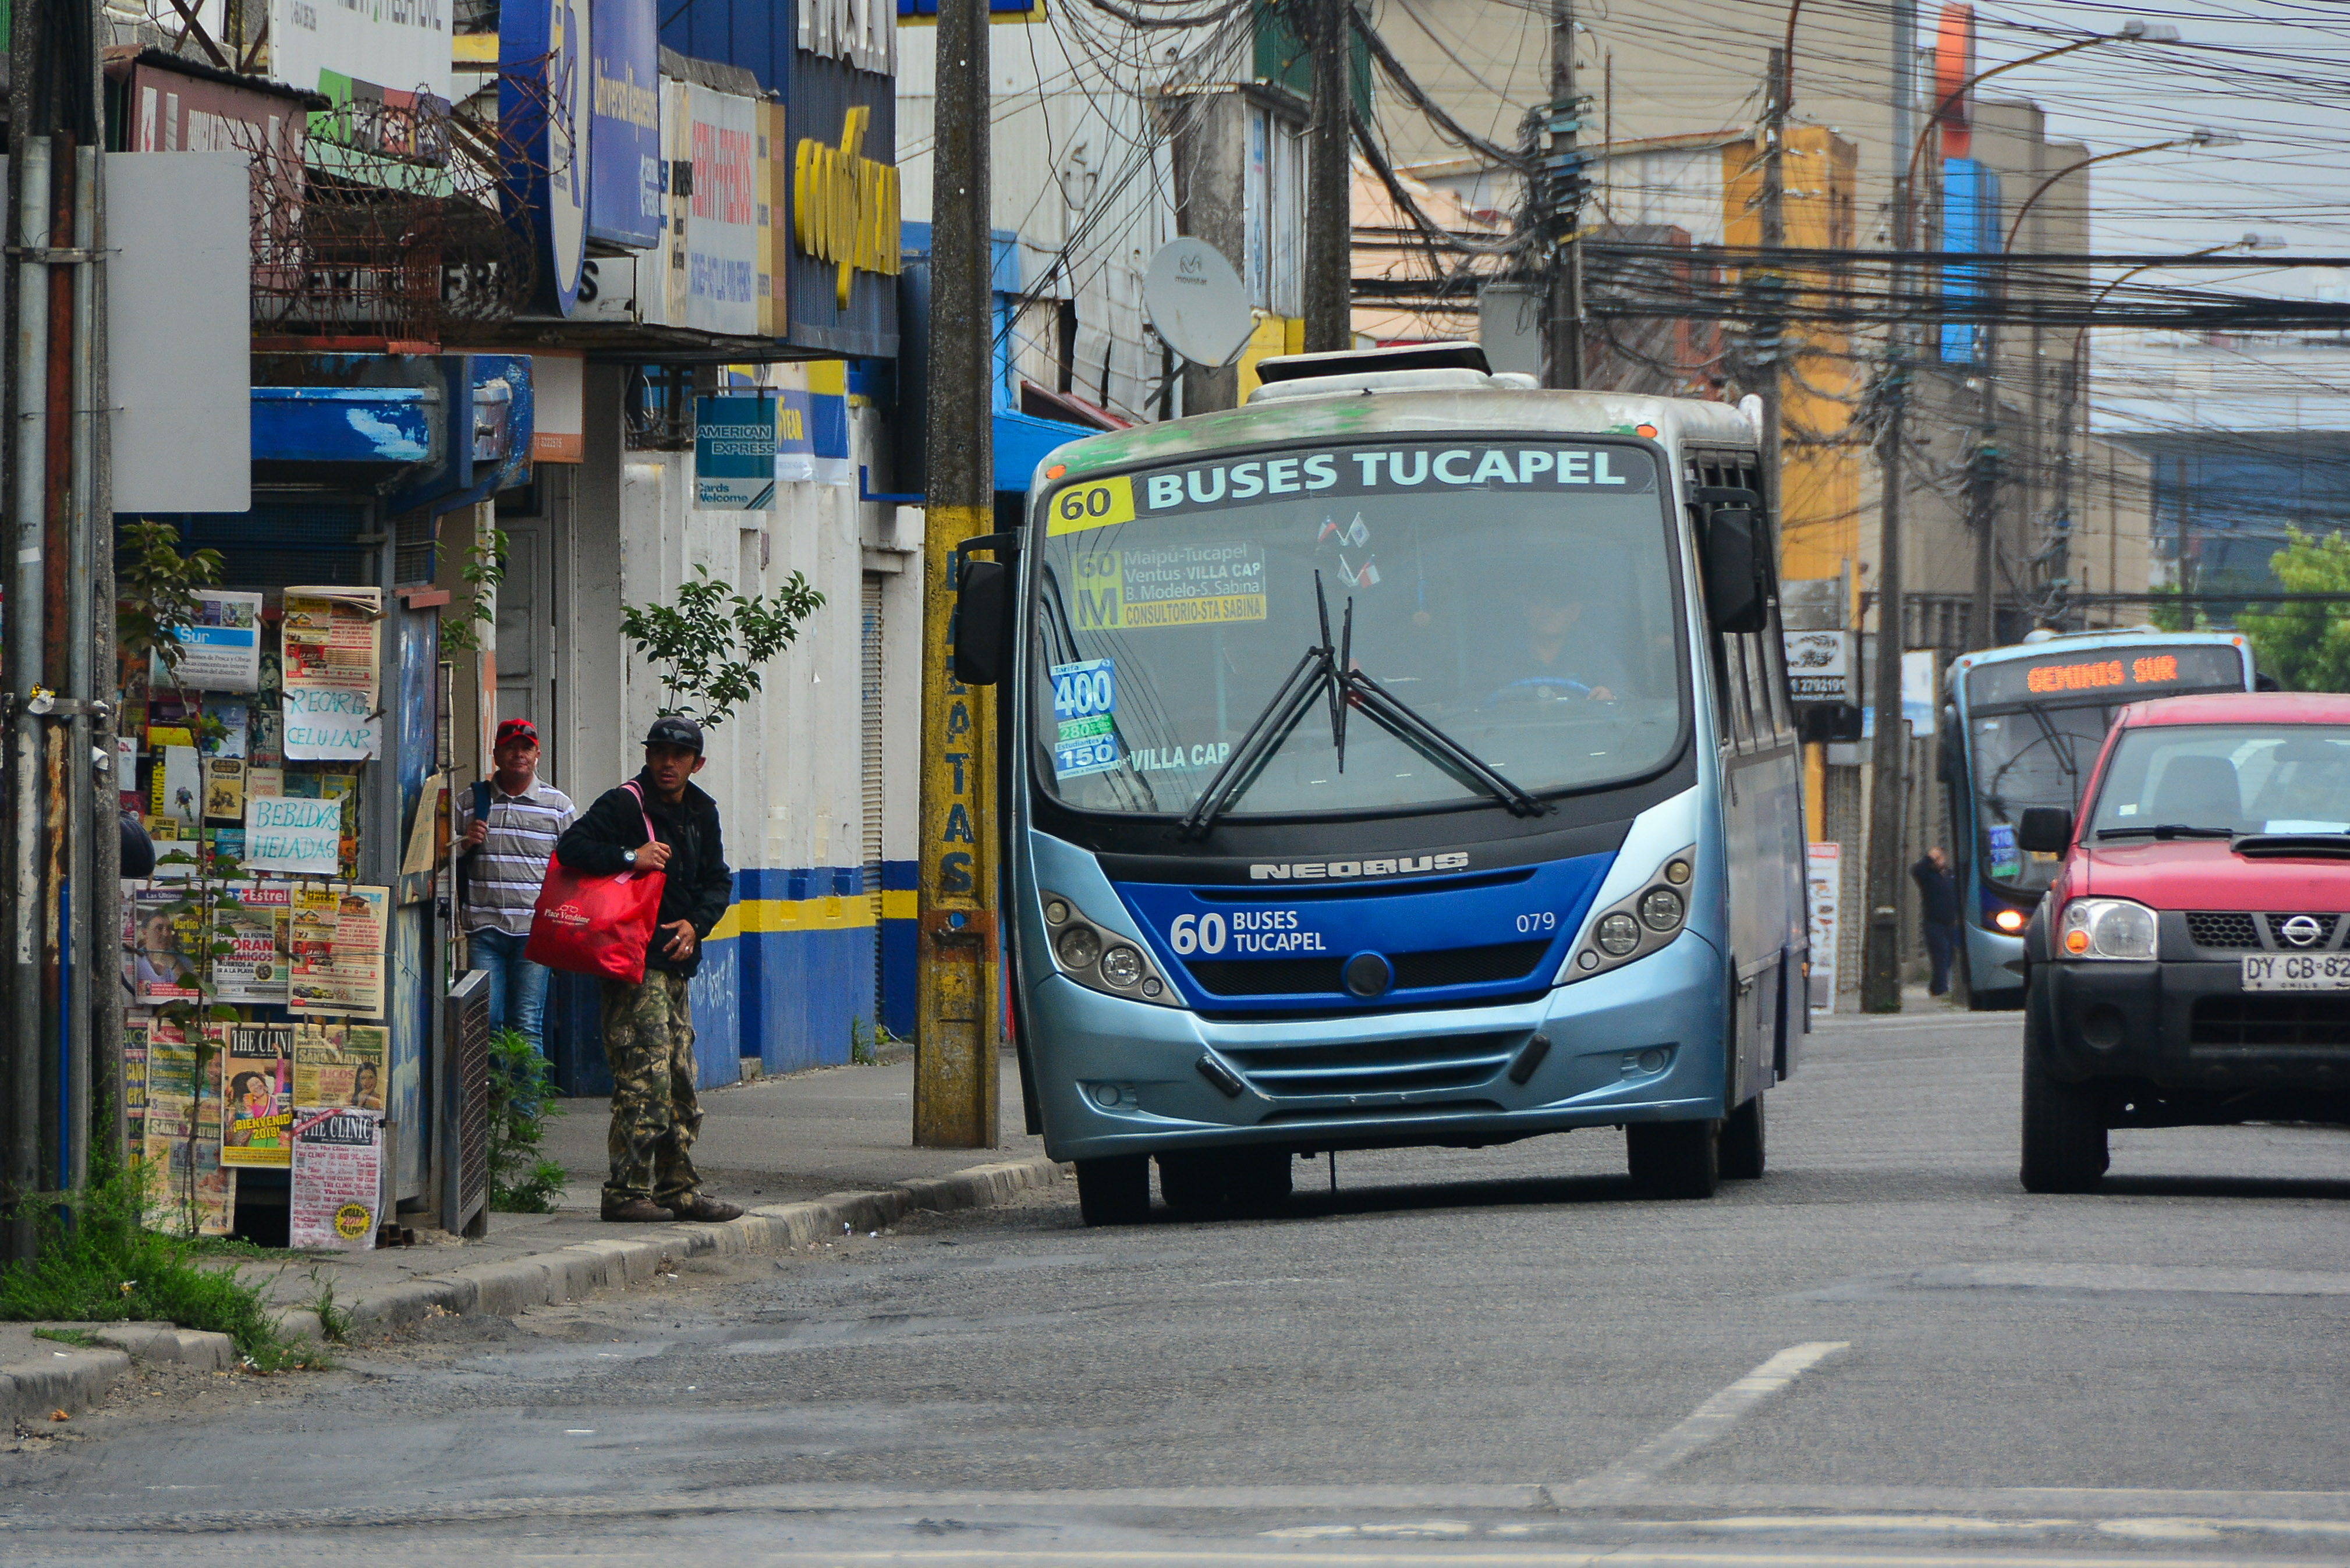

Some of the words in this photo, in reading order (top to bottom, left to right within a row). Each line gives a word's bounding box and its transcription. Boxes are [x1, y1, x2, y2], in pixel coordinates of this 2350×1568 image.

[692, 119, 752, 226] SERVI-FRENOS
[1174, 276, 1208, 288] movistar
[698, 425, 771, 439] AMERICAN
[712, 442, 775, 456] EXPRESS
[1059, 487, 1113, 522] 60
[1147, 454, 1337, 511] BUSES
[1352, 448, 1626, 487] TUCAPEL
[699, 492, 749, 503] Welcome
[1078, 553, 1116, 579] 60
[1124, 568, 1181, 583] Ventus
[1186, 565, 1228, 580] VILLA
[1232, 562, 1261, 577] CAP
[1215, 580, 1260, 595] Sabina
[1079, 587, 1119, 627] M
[1223, 597, 1262, 618] SABINA
[180, 627, 210, 643] Sur
[1055, 664, 1080, 674] Tarifa
[2133, 655, 2178, 683] SUR
[1055, 670, 1112, 716] 400
[287, 726, 371, 749] CELULAR
[1060, 724, 1090, 740] 280
[1057, 737, 1100, 750] Estudiantes
[1059, 744, 1114, 768] 150
[1131, 746, 1186, 771] VILLA
[1191, 742, 1231, 766] CAP
[256, 801, 341, 831] BEBIDAS
[253, 835, 338, 860] HELADAS
[1250, 852, 1469, 879] NEOBUS
[249, 889, 288, 902] Estrel
[544, 908, 560, 918] Place
[1516, 911, 1556, 932] 079
[1169, 912, 1227, 955] 60
[1233, 911, 1298, 931] BUSES
[1233, 931, 1327, 953] TUCAPEL
[217, 939, 274, 952] ORAN
[228, 952, 274, 962] AMIGOS
[2248, 957, 2275, 979] DY
[232, 1030, 256, 1052] THE
[259, 1030, 291, 1053] CLINI
[336, 1052, 380, 1066] NATURAL
[234, 1113, 292, 1133] ¡BIENVENID
[253, 1127, 281, 1140] 2018!
[303, 1115, 326, 1137] THE
[329, 1116, 372, 1139] CLINIC
[343, 1216, 363, 1226] 2017
